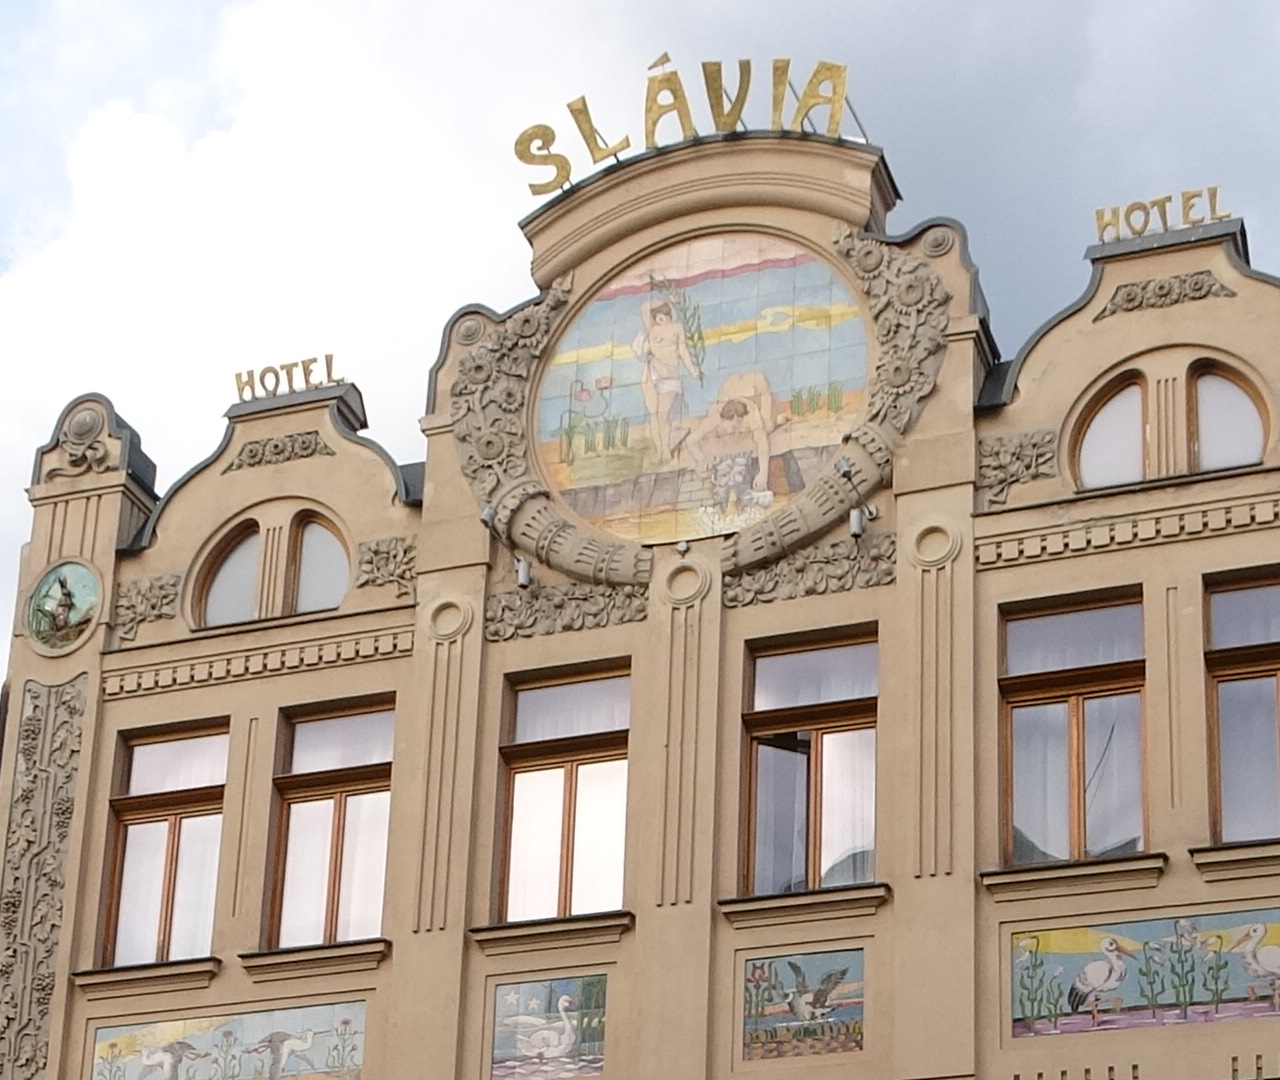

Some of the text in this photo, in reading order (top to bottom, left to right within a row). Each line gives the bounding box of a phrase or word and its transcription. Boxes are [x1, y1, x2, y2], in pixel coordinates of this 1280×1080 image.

[513, 51, 848, 196] SLÁVIA
[1095, 186, 1231, 243] HOTEL
[235, 354, 344, 401] HOTEL
